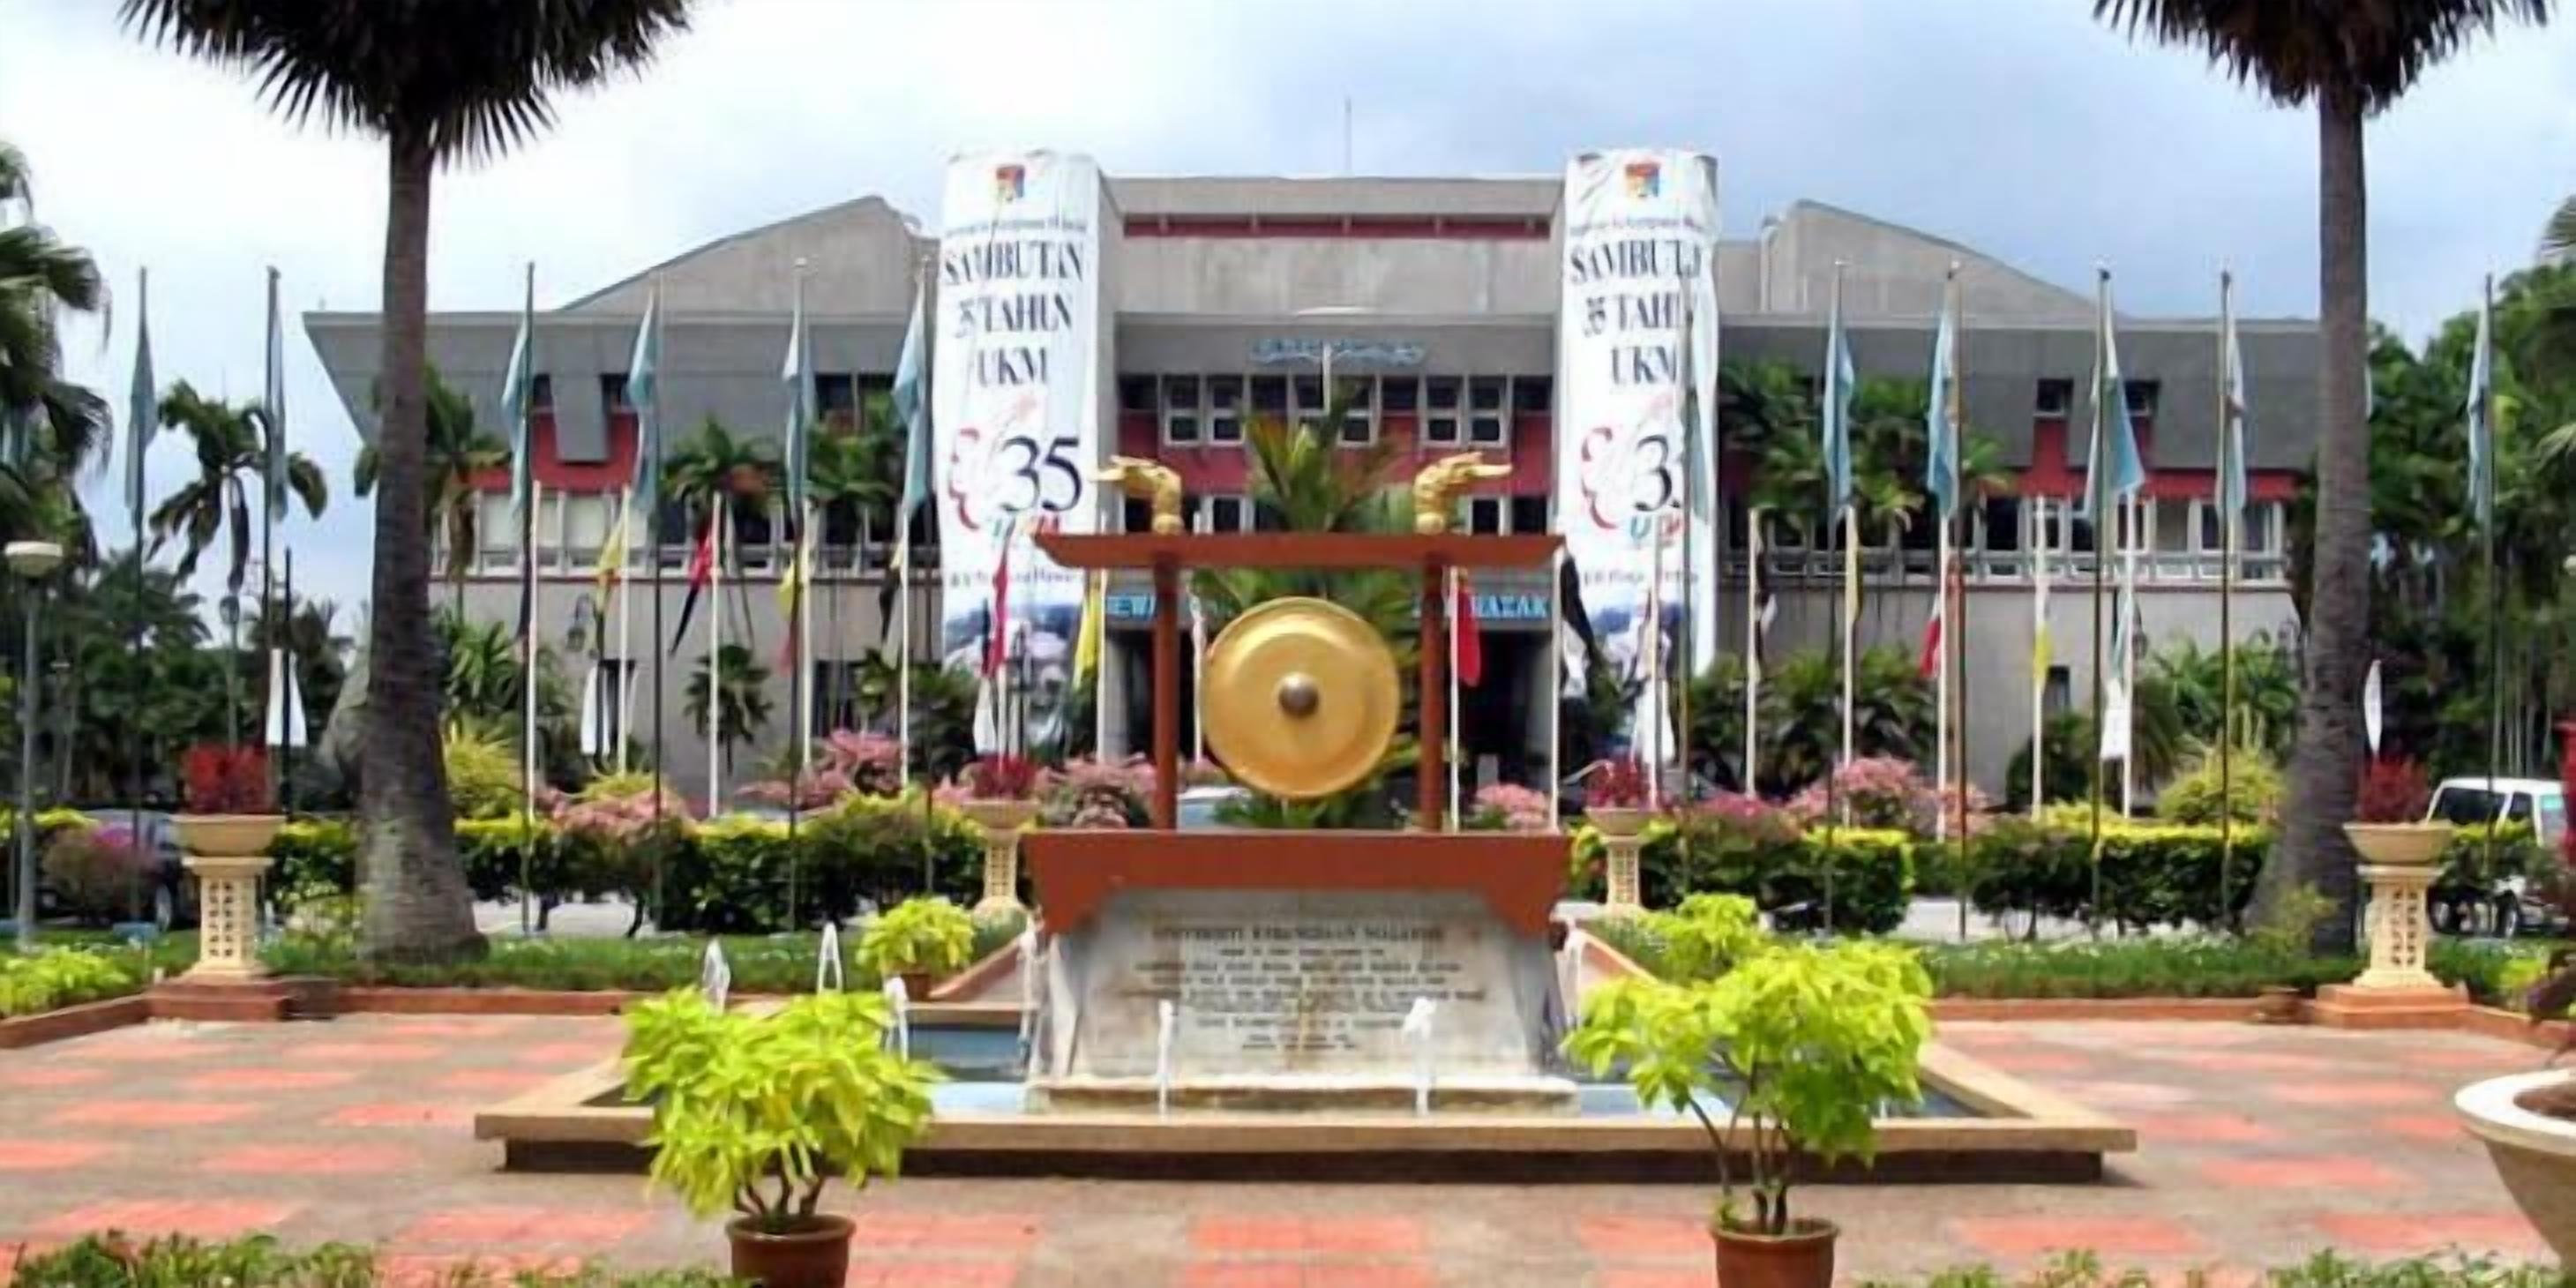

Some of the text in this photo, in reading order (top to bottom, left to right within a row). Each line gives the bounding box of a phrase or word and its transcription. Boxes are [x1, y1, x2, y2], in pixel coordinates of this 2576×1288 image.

[943, 238, 1084, 285] SAMBUTAN
[977, 291, 1074, 333] TAHUN
[977, 345, 1048, 386] UKM
[999, 433, 1083, 513] 35
[1630, 433, 1681, 513] 3
